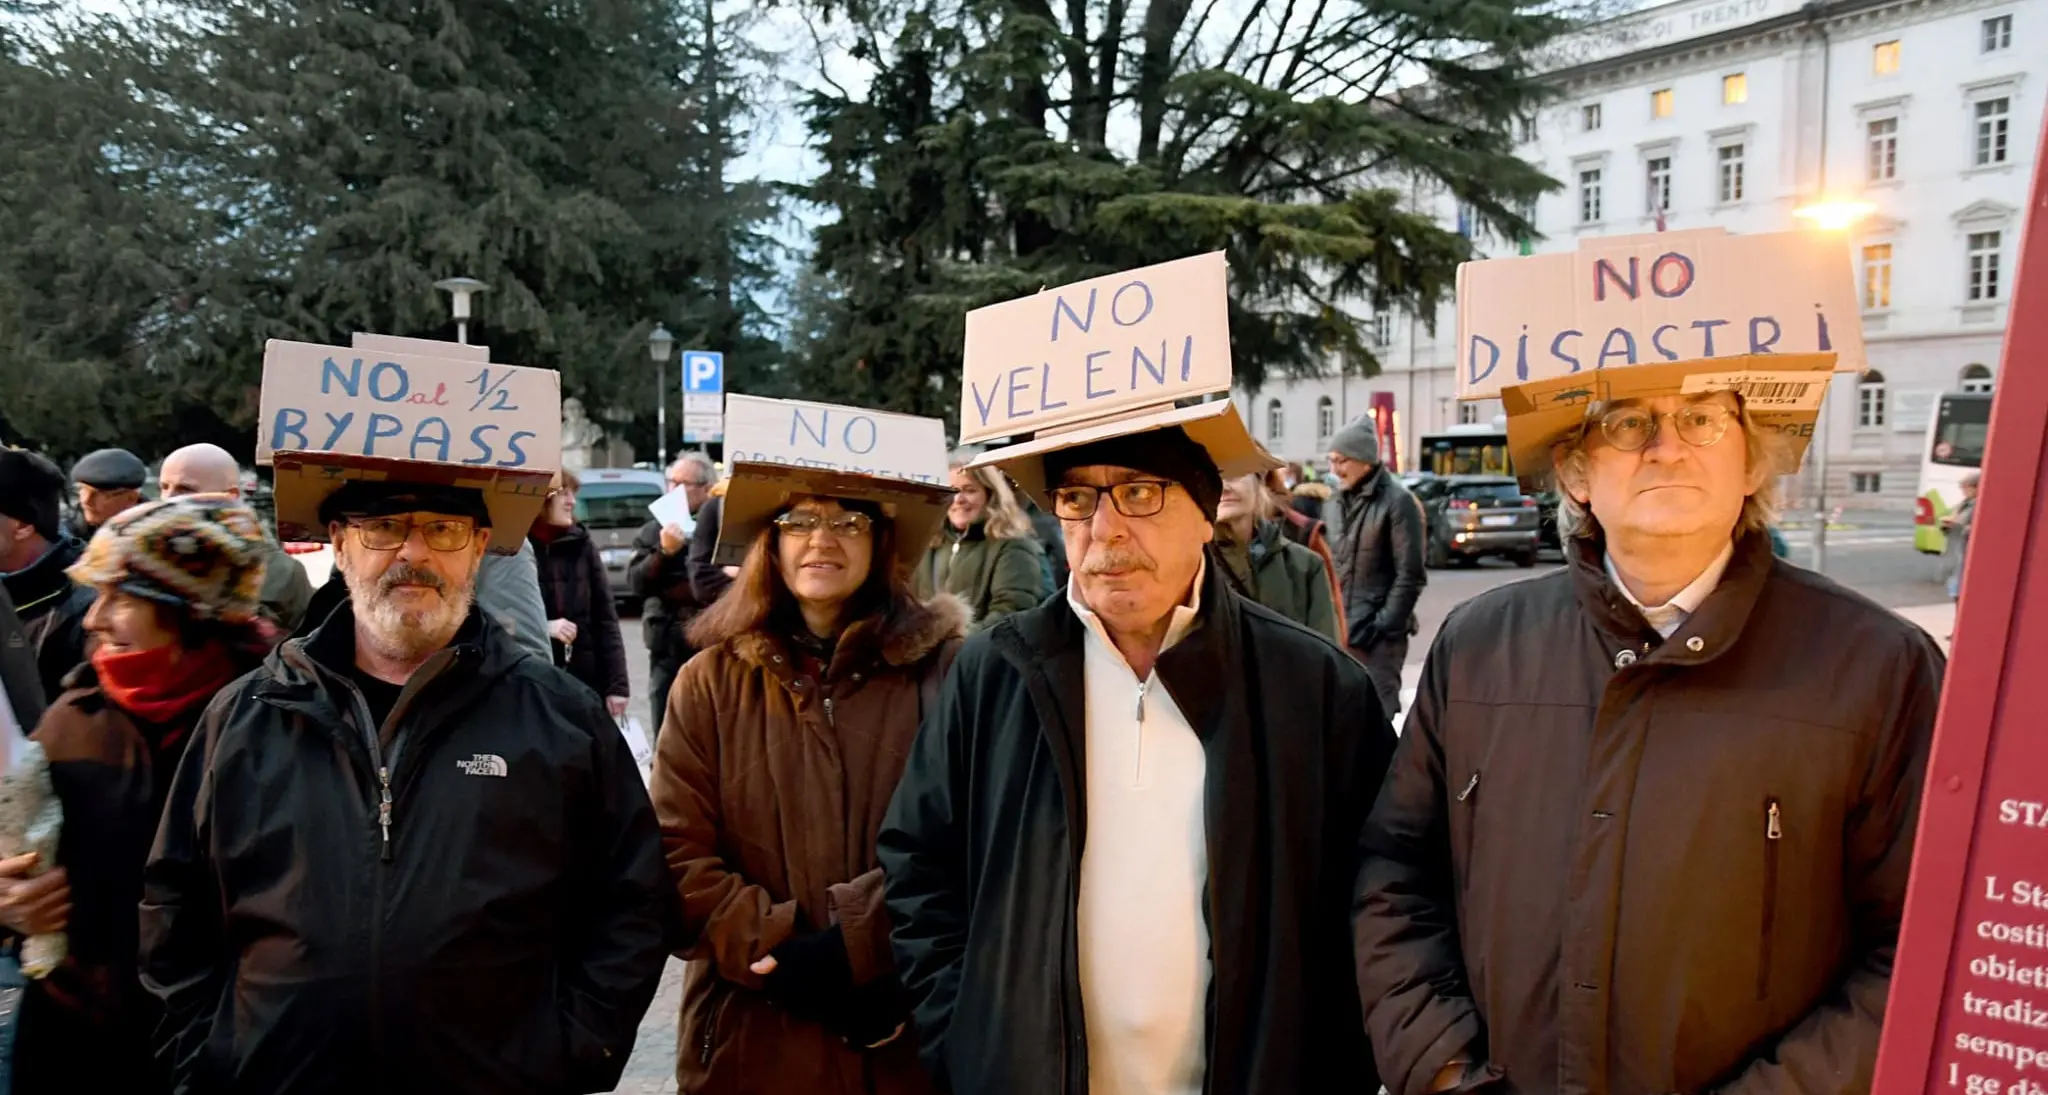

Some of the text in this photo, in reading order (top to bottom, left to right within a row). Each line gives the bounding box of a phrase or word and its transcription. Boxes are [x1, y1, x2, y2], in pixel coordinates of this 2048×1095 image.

[1689, 0, 1768, 29] TRENTO
[1593, 251, 1695, 302] NO
[1051, 280, 1154, 343] NO
[321, 356, 409, 403] NO
[690, 356, 717, 390] P
[971, 335, 1192, 426] VELENI
[270, 407, 537, 467] BYPASS
[790, 408, 877, 454] NO
[1976, 920, 2048, 948] costi
[1969, 954, 2048, 989] obiet
